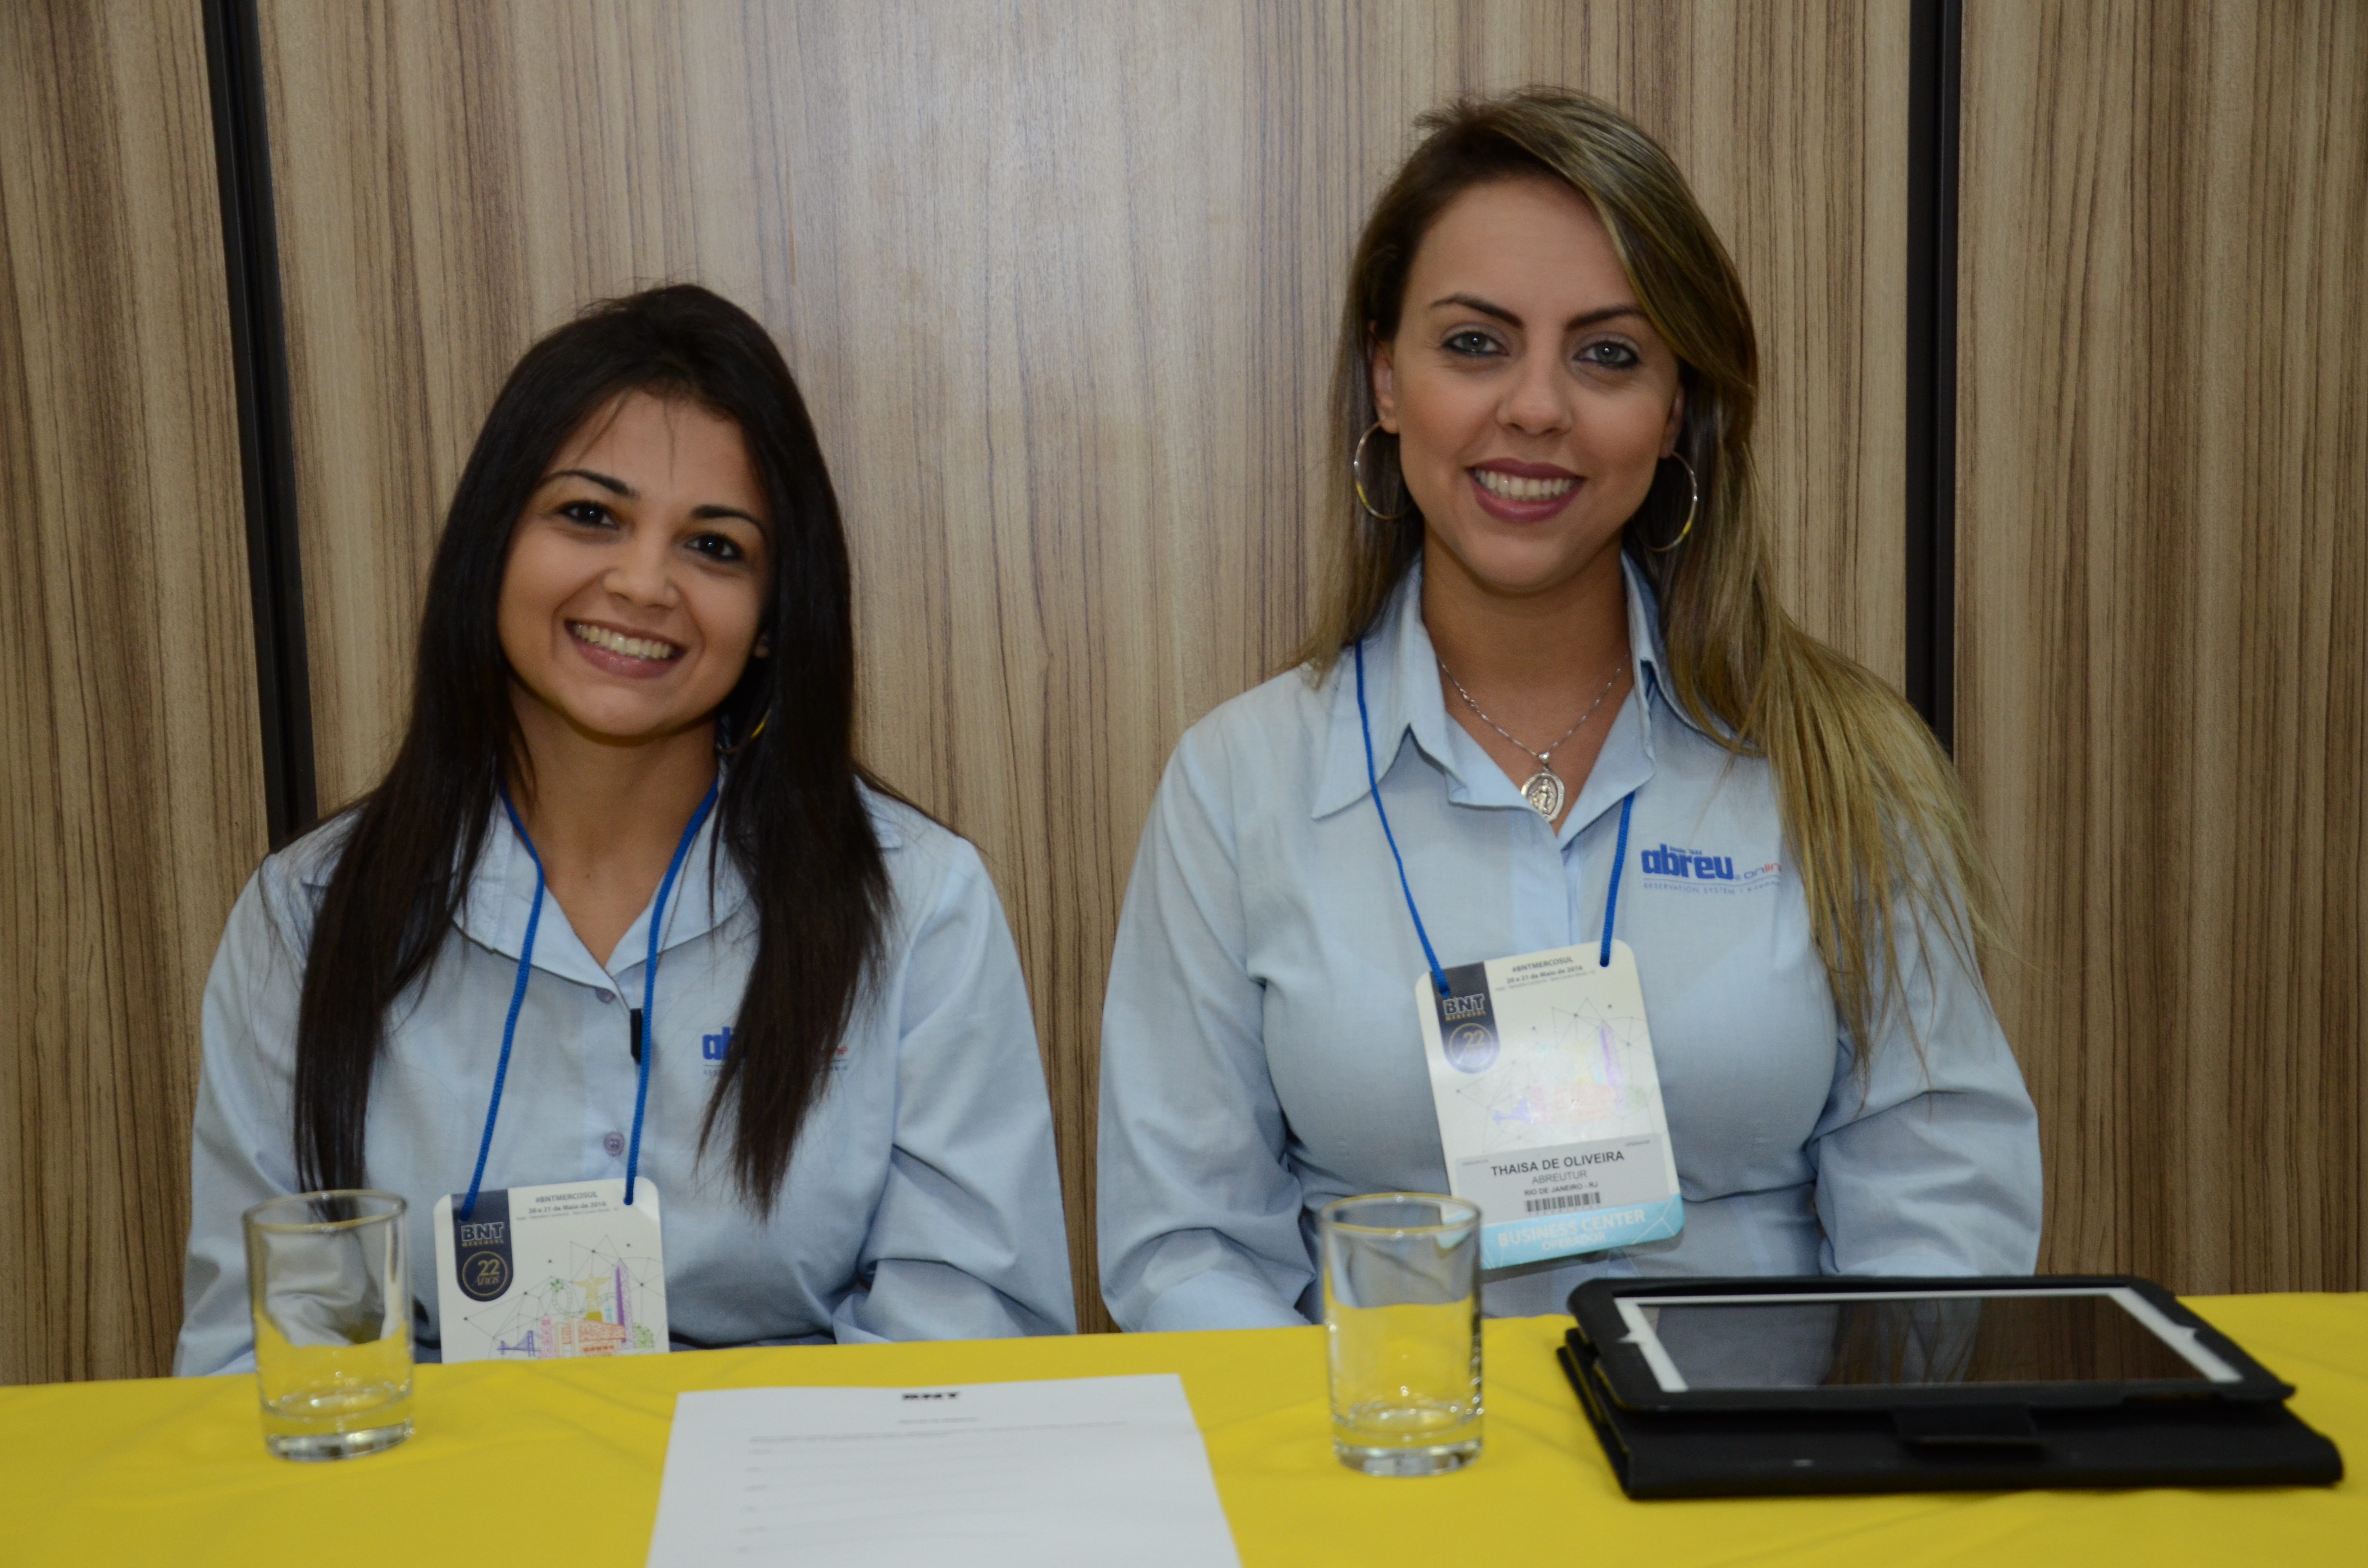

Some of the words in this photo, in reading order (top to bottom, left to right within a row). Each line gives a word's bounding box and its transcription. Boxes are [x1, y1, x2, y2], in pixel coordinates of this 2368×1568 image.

[1641, 843, 1734, 880] abreu
[1744, 863, 1782, 878] onlin
[1443, 993, 1485, 1016] BNT
[1491, 1161, 1539, 1176] THAISA
[1542, 1158, 1560, 1170] DE
[1564, 1151, 1625, 1167] OLIVEIRA
[1532, 1169, 1588, 1185] ABREUTUR
[535, 1191, 598, 1203] #BNTMERCOSUL
[1551, 1183, 1583, 1193] JANEIRO
[461, 1222, 504, 1242] BNT
[1497, 1219, 1579, 1248] BUSINESS
[1581, 1208, 1646, 1232] CENTER
[1542, 1231, 1606, 1250] OPERADOR
[477, 1258, 500, 1278] 22
